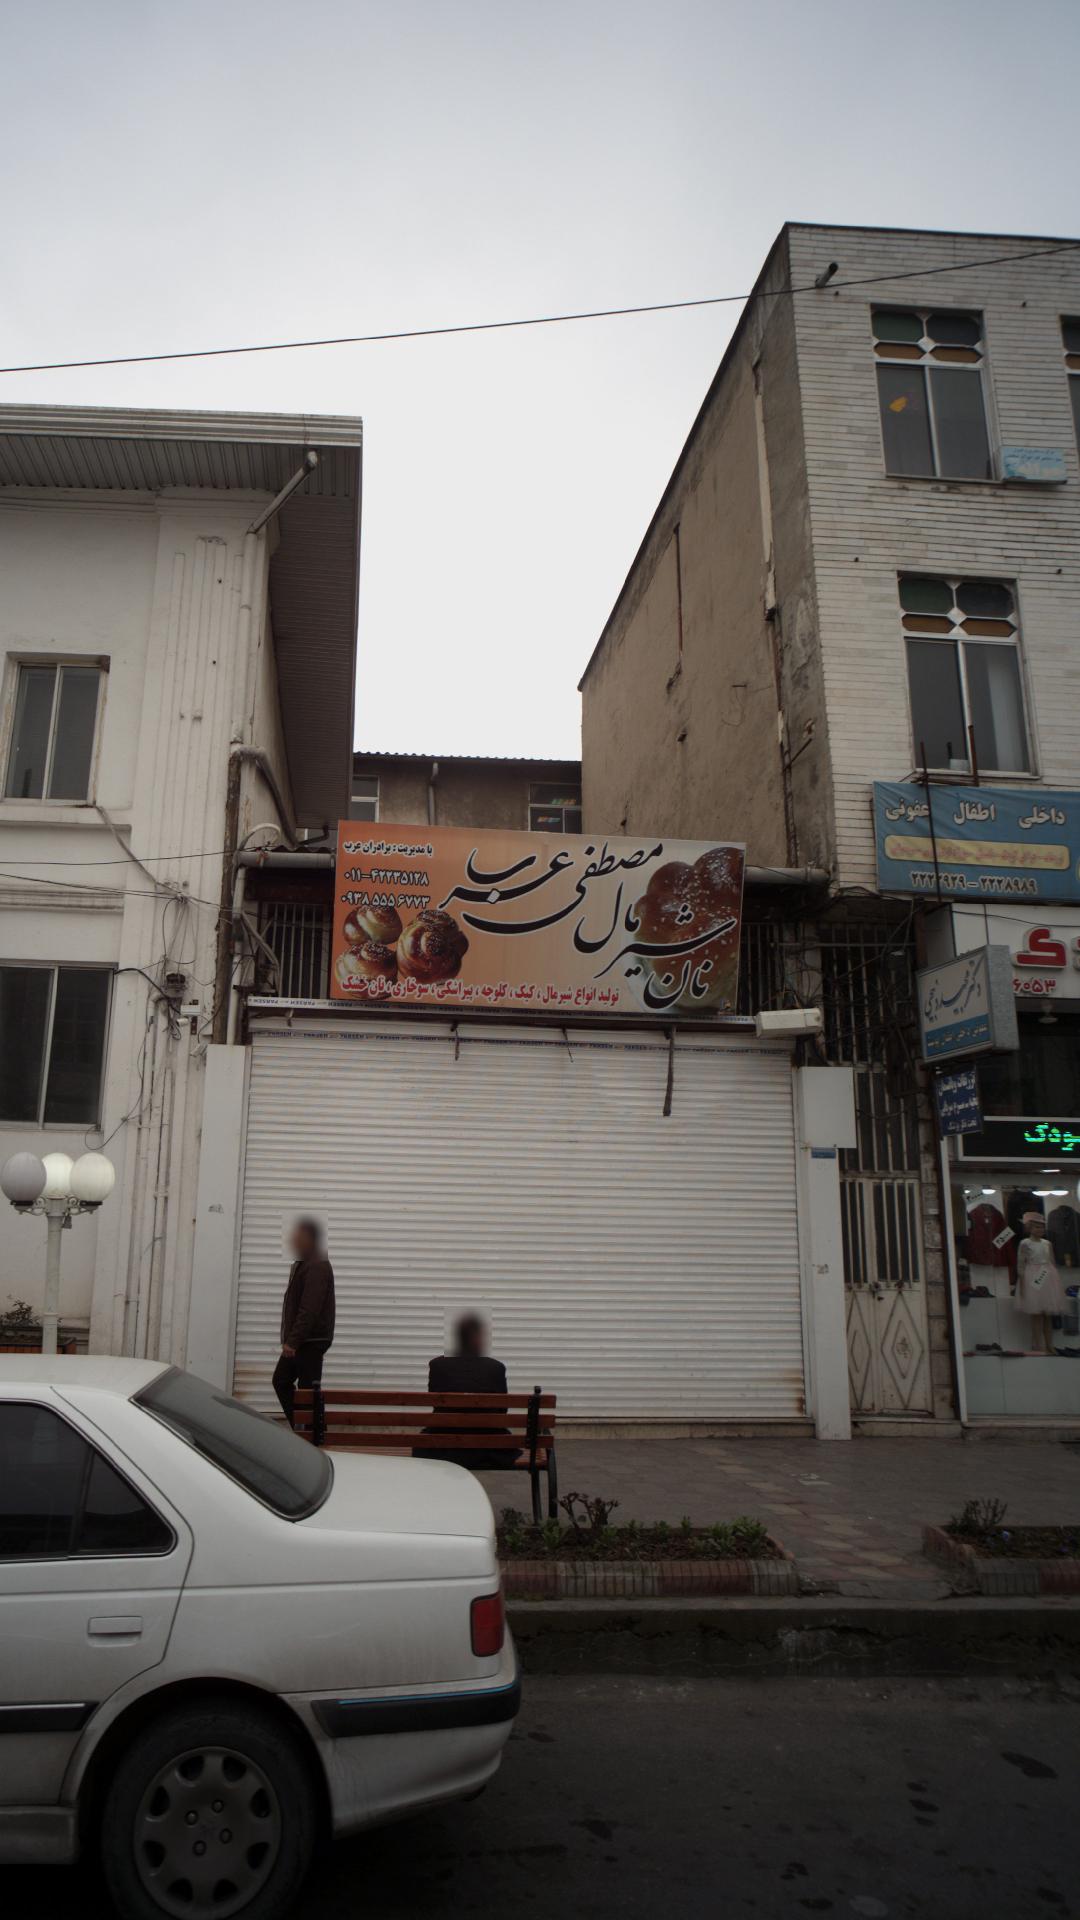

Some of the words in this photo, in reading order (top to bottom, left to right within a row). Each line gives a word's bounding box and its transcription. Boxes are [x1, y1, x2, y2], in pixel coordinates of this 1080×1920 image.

[885, 798, 930, 822] عفونی
[953, 801, 996, 825] اطفال
[1018, 806, 1066, 829] داخلی
[344, 841, 361, 852] عرب
[362, 840, 391, 855] برادران
[438, 847, 575, 910] عرب
[461, 841, 664, 935] مصطفی
[341, 975, 369, 992] خشک
[368, 975, 386, 996] نان
[644, 959, 712, 1010] نان
[574, 985, 596, 1005] انواع
[598, 986, 620, 1006] تولید
